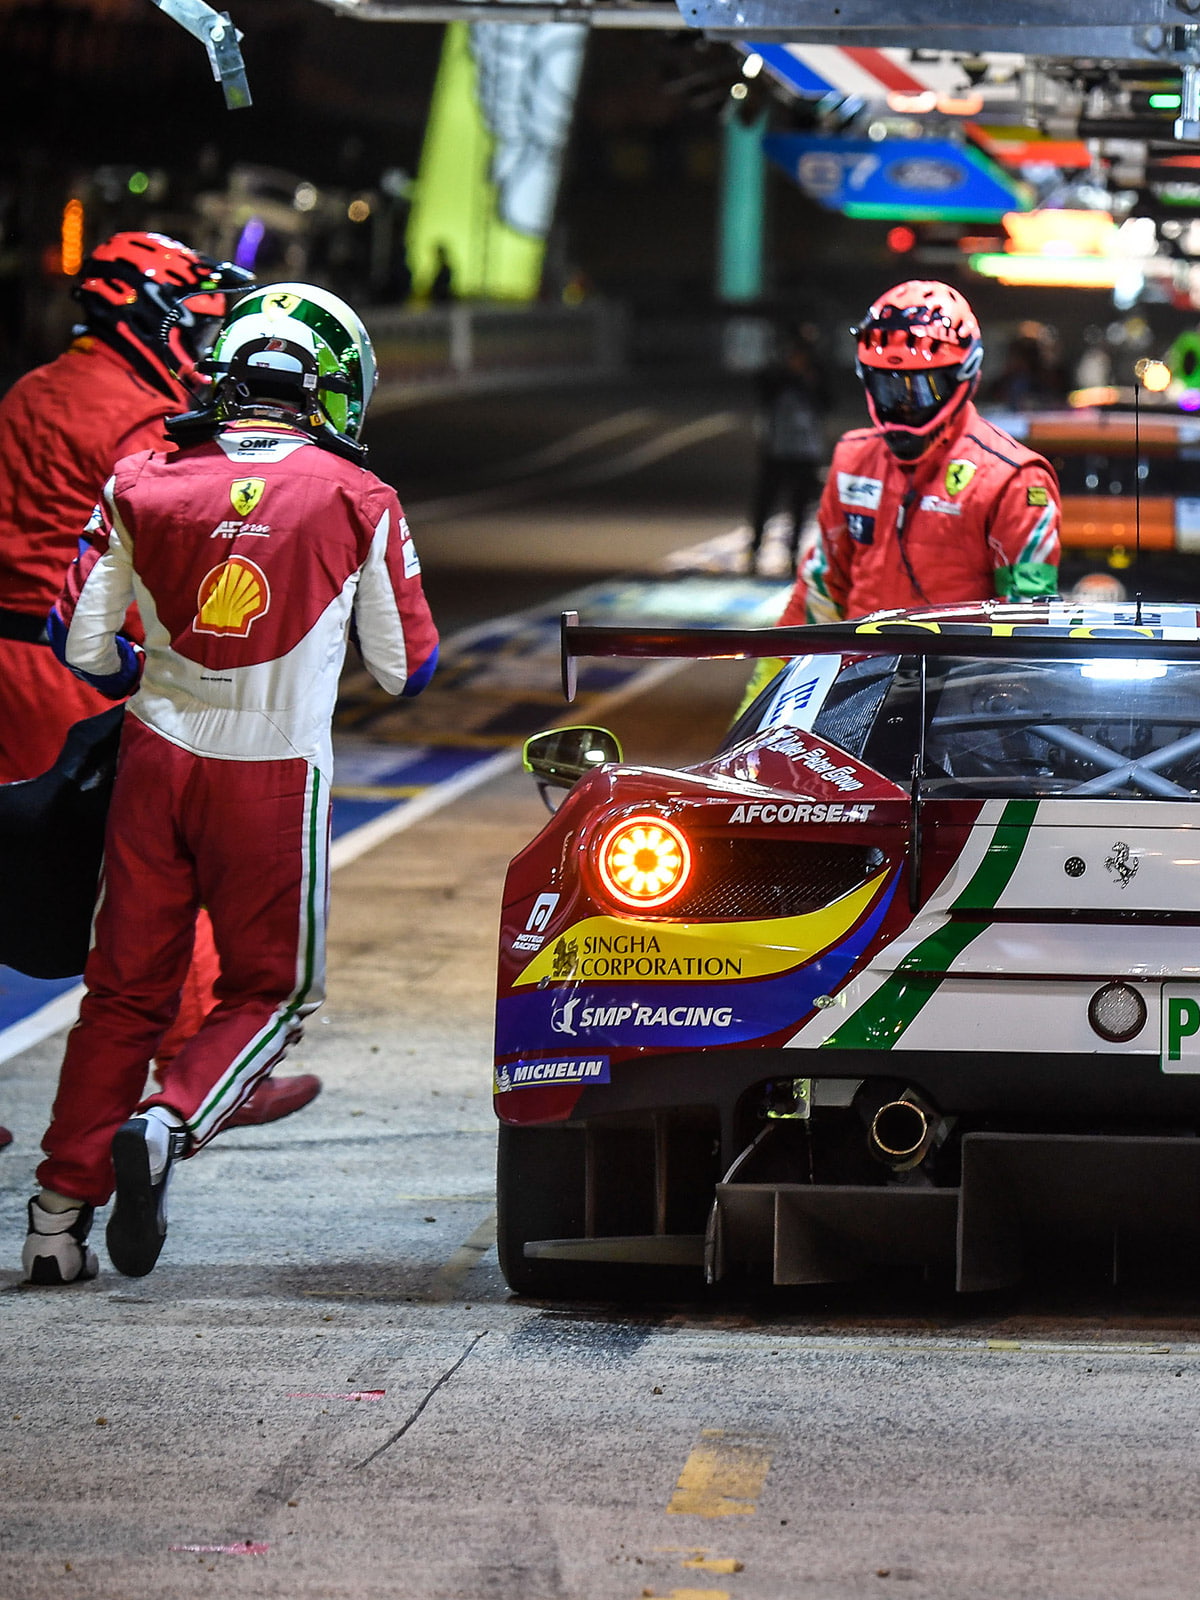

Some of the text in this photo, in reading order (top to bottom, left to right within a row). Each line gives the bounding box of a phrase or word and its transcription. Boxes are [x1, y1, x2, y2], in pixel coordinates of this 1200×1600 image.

[240, 439, 279, 449] OMP
[821, 766, 864, 791] Group
[728, 804, 876, 823] AFCORSE.IT
[583, 935, 661, 954] SINGHA
[581, 957, 742, 976] CORPORATION
[579, 1007, 733, 1027] SMP RACING
[513, 1061, 603, 1082] MICHELIN
